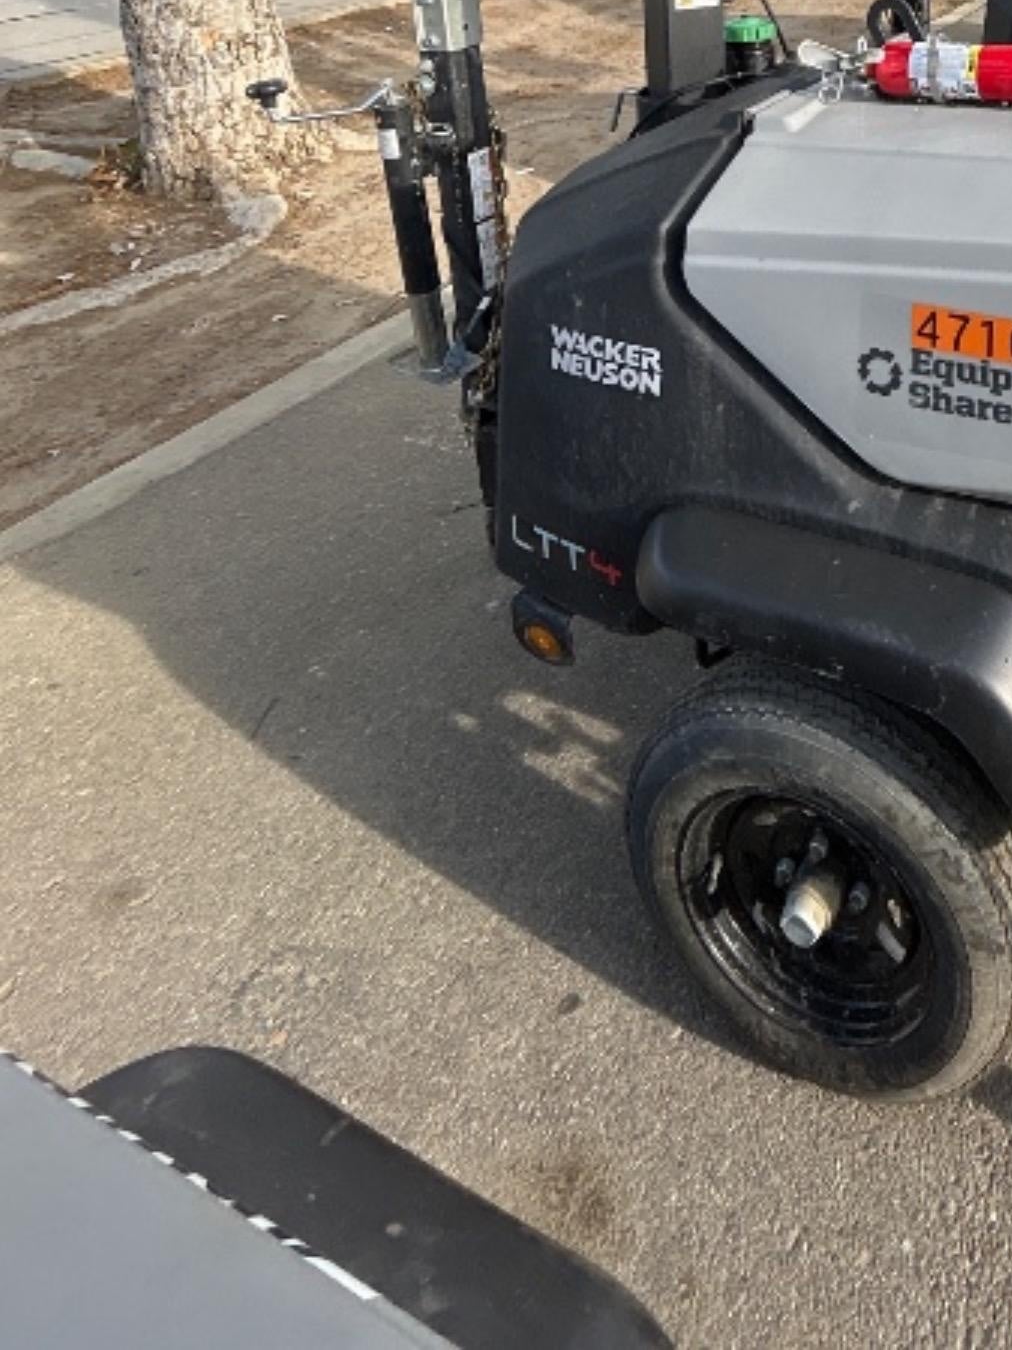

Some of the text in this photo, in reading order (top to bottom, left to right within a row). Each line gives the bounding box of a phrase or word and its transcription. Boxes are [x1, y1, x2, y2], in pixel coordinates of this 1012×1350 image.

[551, 324, 661, 372] WACKER
[551, 347, 661, 397] NEUSON
[511, 514, 622, 586] LTT4
